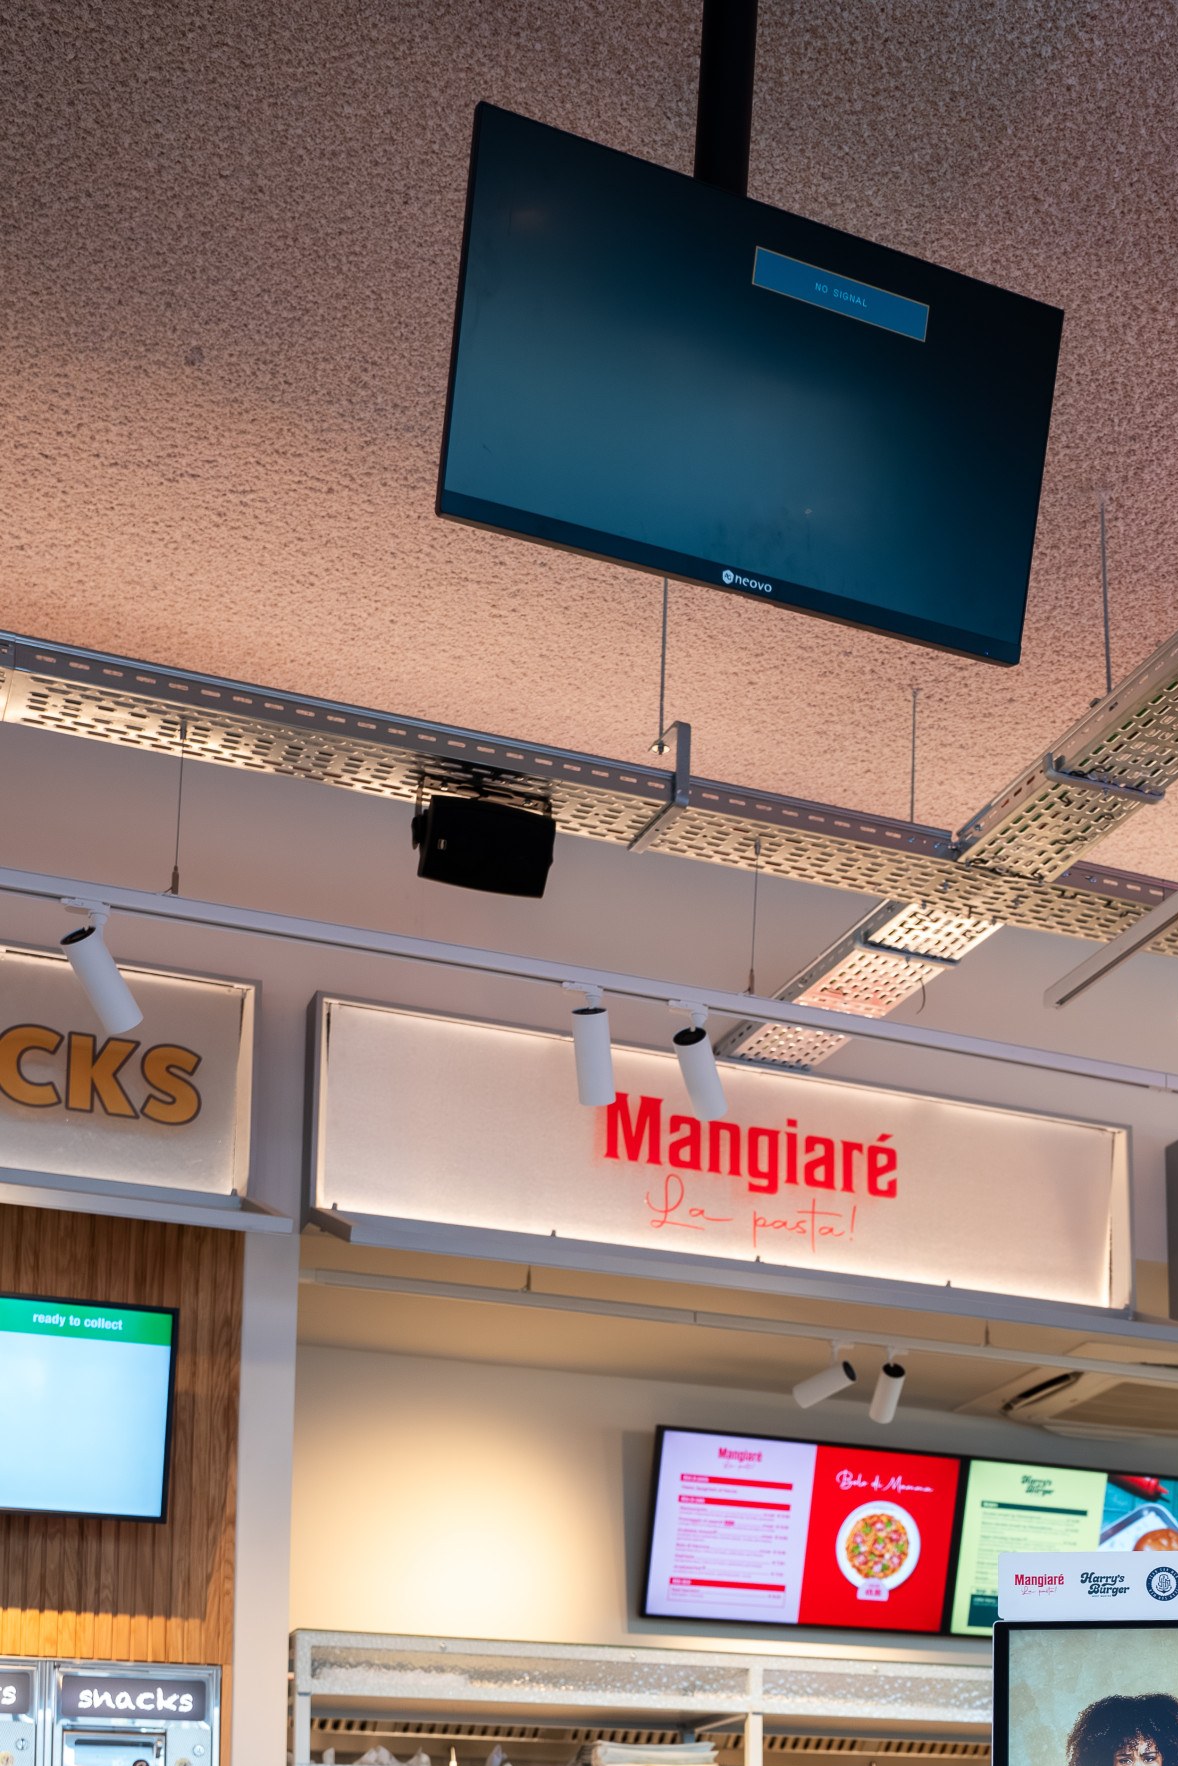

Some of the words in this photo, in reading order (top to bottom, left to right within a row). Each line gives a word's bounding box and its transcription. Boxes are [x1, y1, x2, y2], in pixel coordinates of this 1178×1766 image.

[815, 282, 828, 293] NO
[833, 288, 868, 308] SIGNAL
[735, 574, 772, 593] neovo
[603, 1091, 898, 1199] Mangiaré
[644, 1173, 733, 1230] La
[752, 1198, 857, 1253] pasta!
[32, 1313, 66, 1328] ready
[69, 1315, 81, 1327] to
[84, 1317, 123, 1331] collect
[1014, 1573, 1065, 1588] Mangiaré
[1080, 1571, 1125, 1586] Harry's
[1088, 1583, 1130, 1597] Burger
[78, 1687, 194, 1713] snacks
